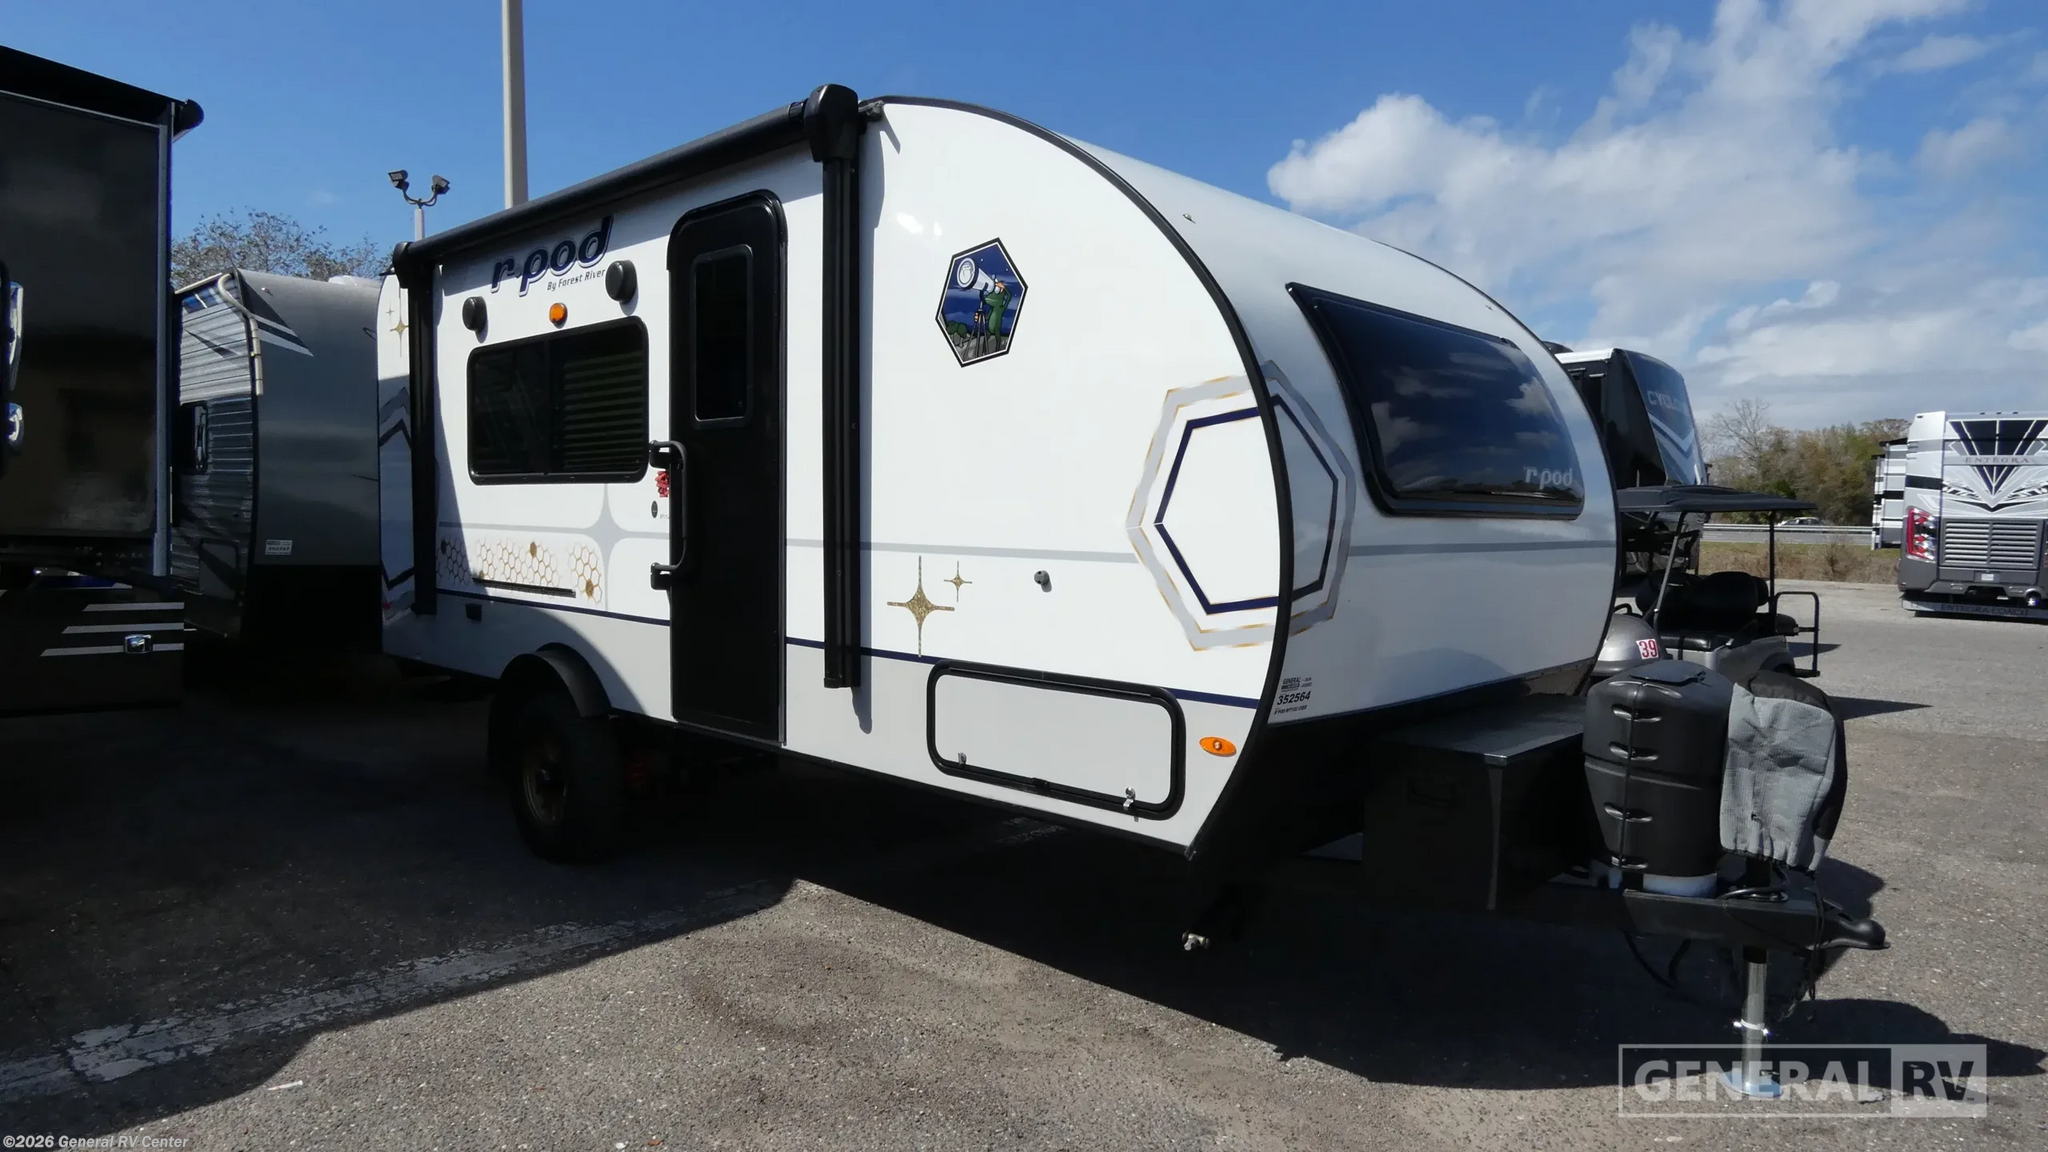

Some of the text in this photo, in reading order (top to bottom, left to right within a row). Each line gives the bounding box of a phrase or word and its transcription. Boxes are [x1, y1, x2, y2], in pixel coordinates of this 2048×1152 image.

[547, 269, 605, 291] By Forest River
[1965, 456, 2030, 464] ENTEGRA
[1638, 640, 1658, 658] 39
[1276, 690, 1312, 706] 352564
